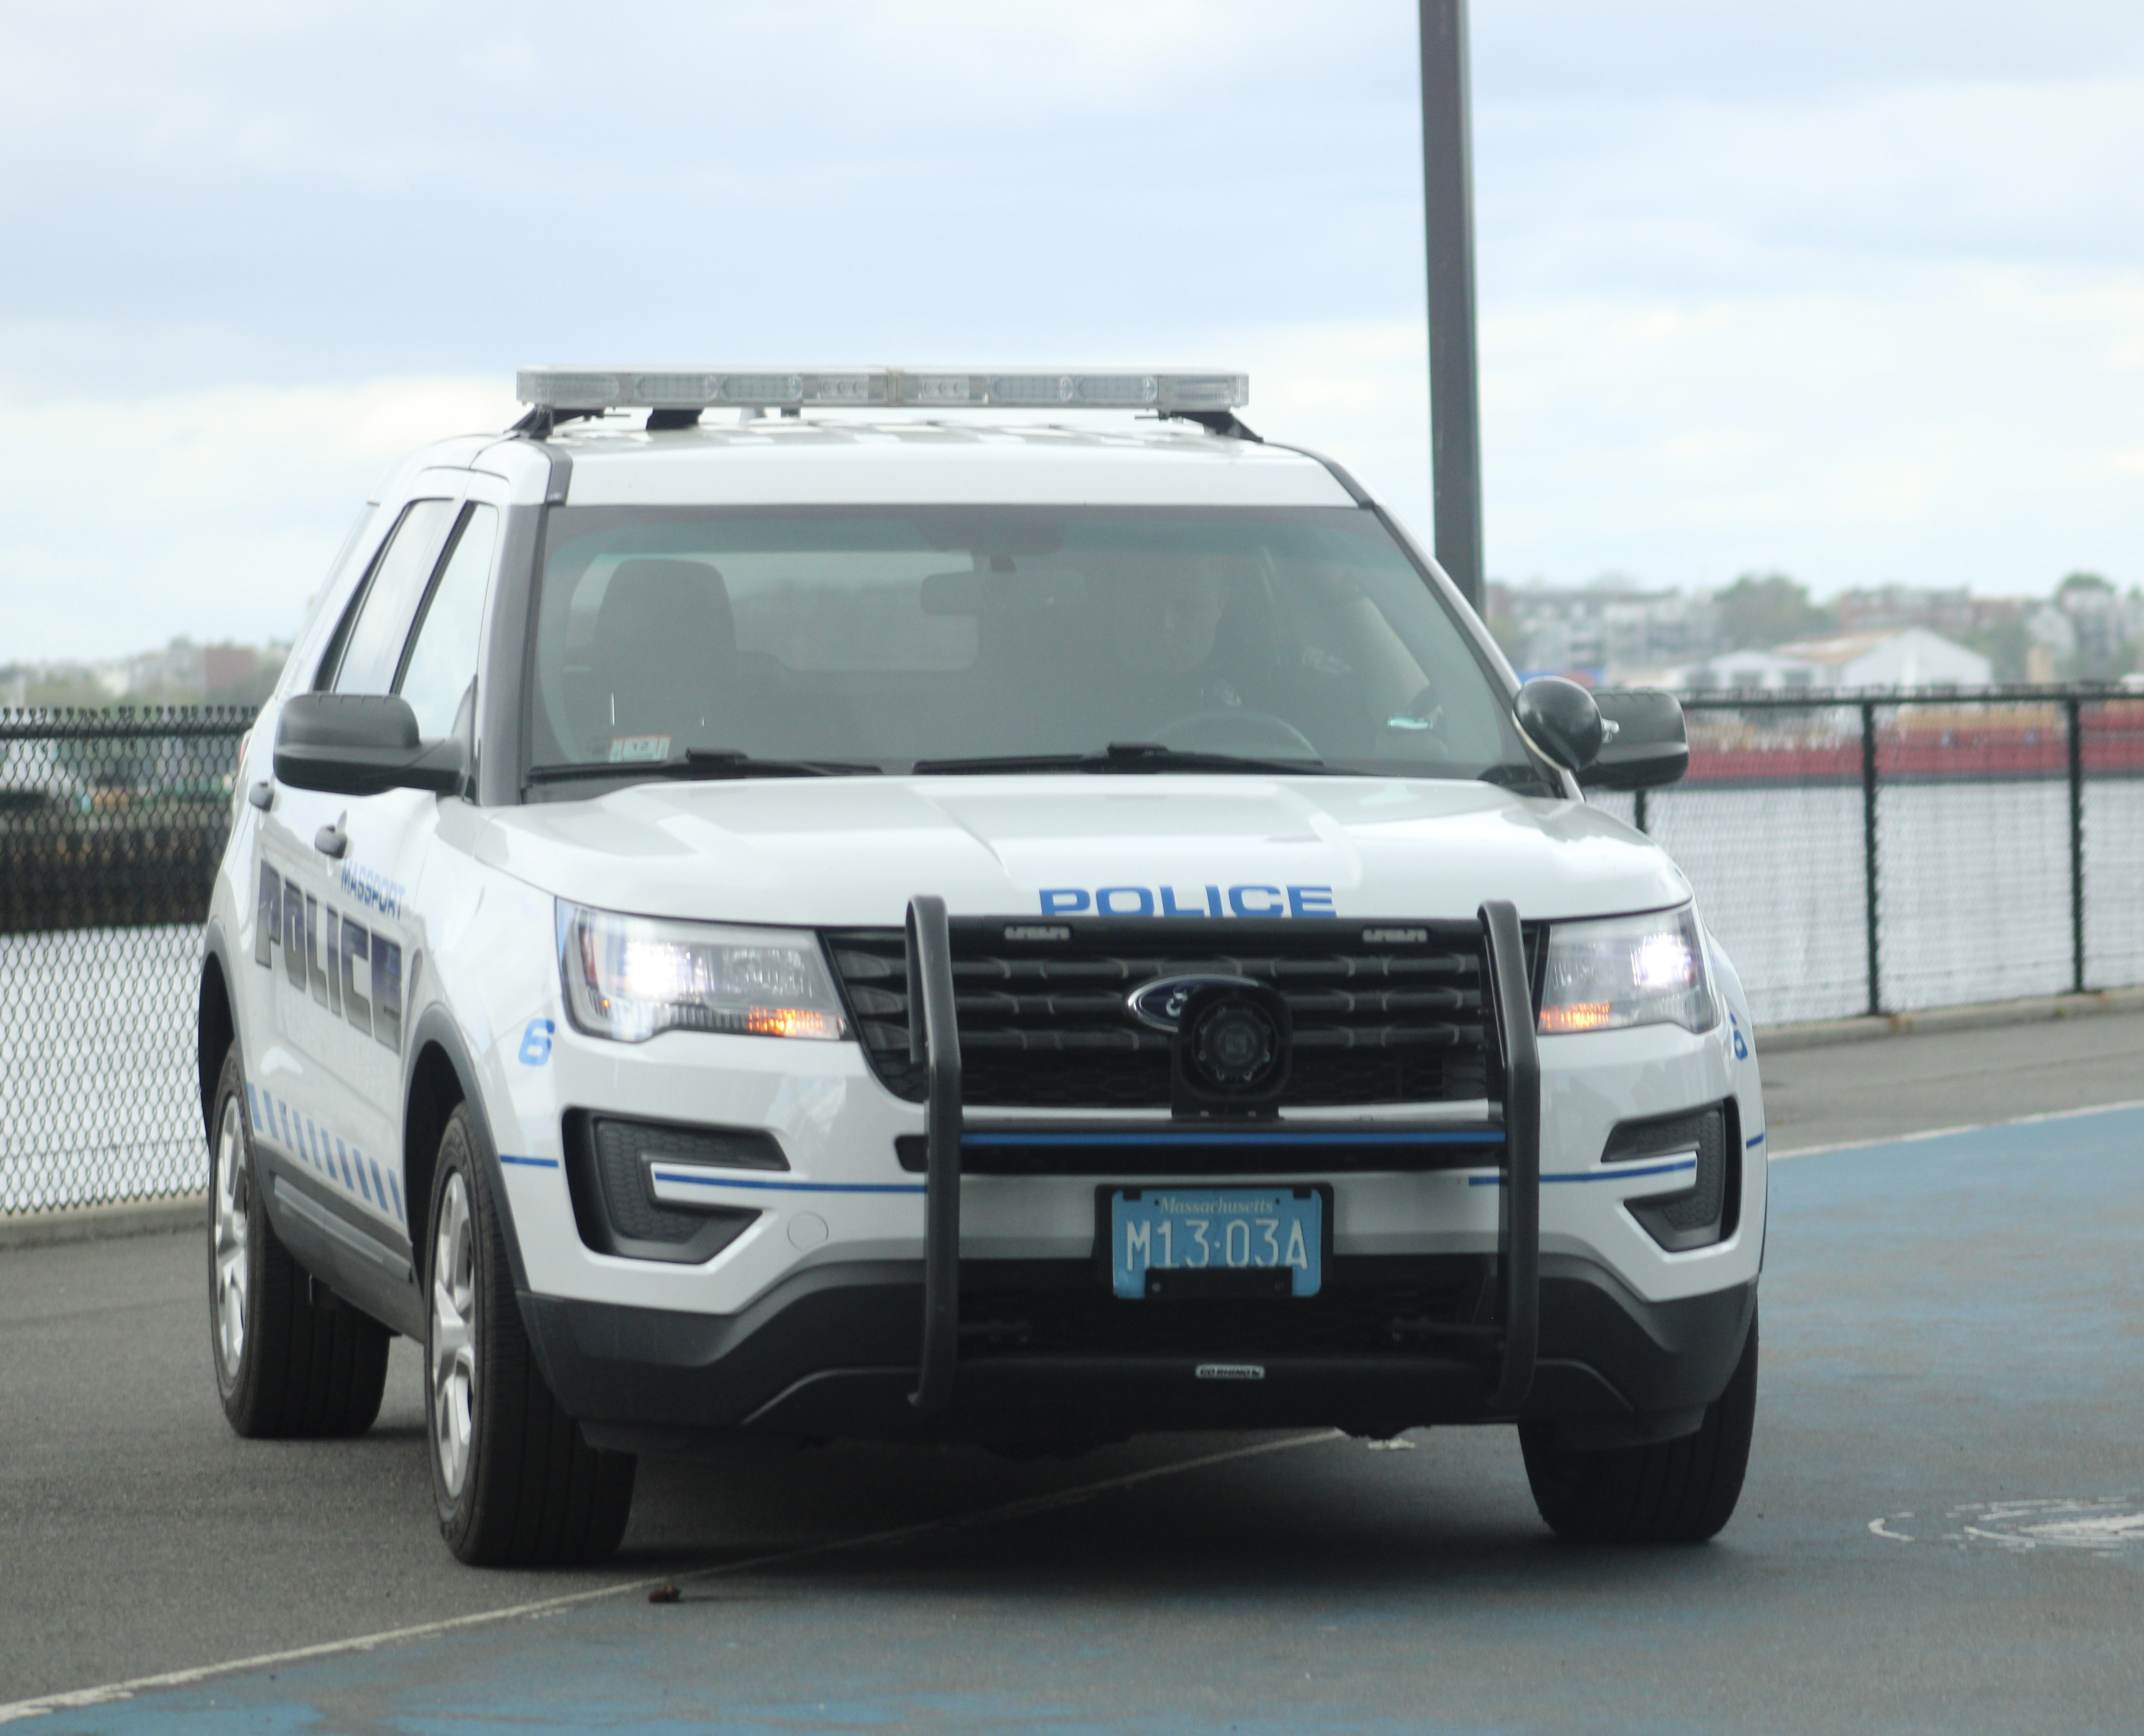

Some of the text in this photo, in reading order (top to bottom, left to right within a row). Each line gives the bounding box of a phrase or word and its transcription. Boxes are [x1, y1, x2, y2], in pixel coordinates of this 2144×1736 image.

[1039, 884, 1337, 918] POLICE
[255, 859, 402, 1058] POLICE
[519, 1018, 555, 1067] 6
[1160, 1196, 1273, 1214] Massachusetts
